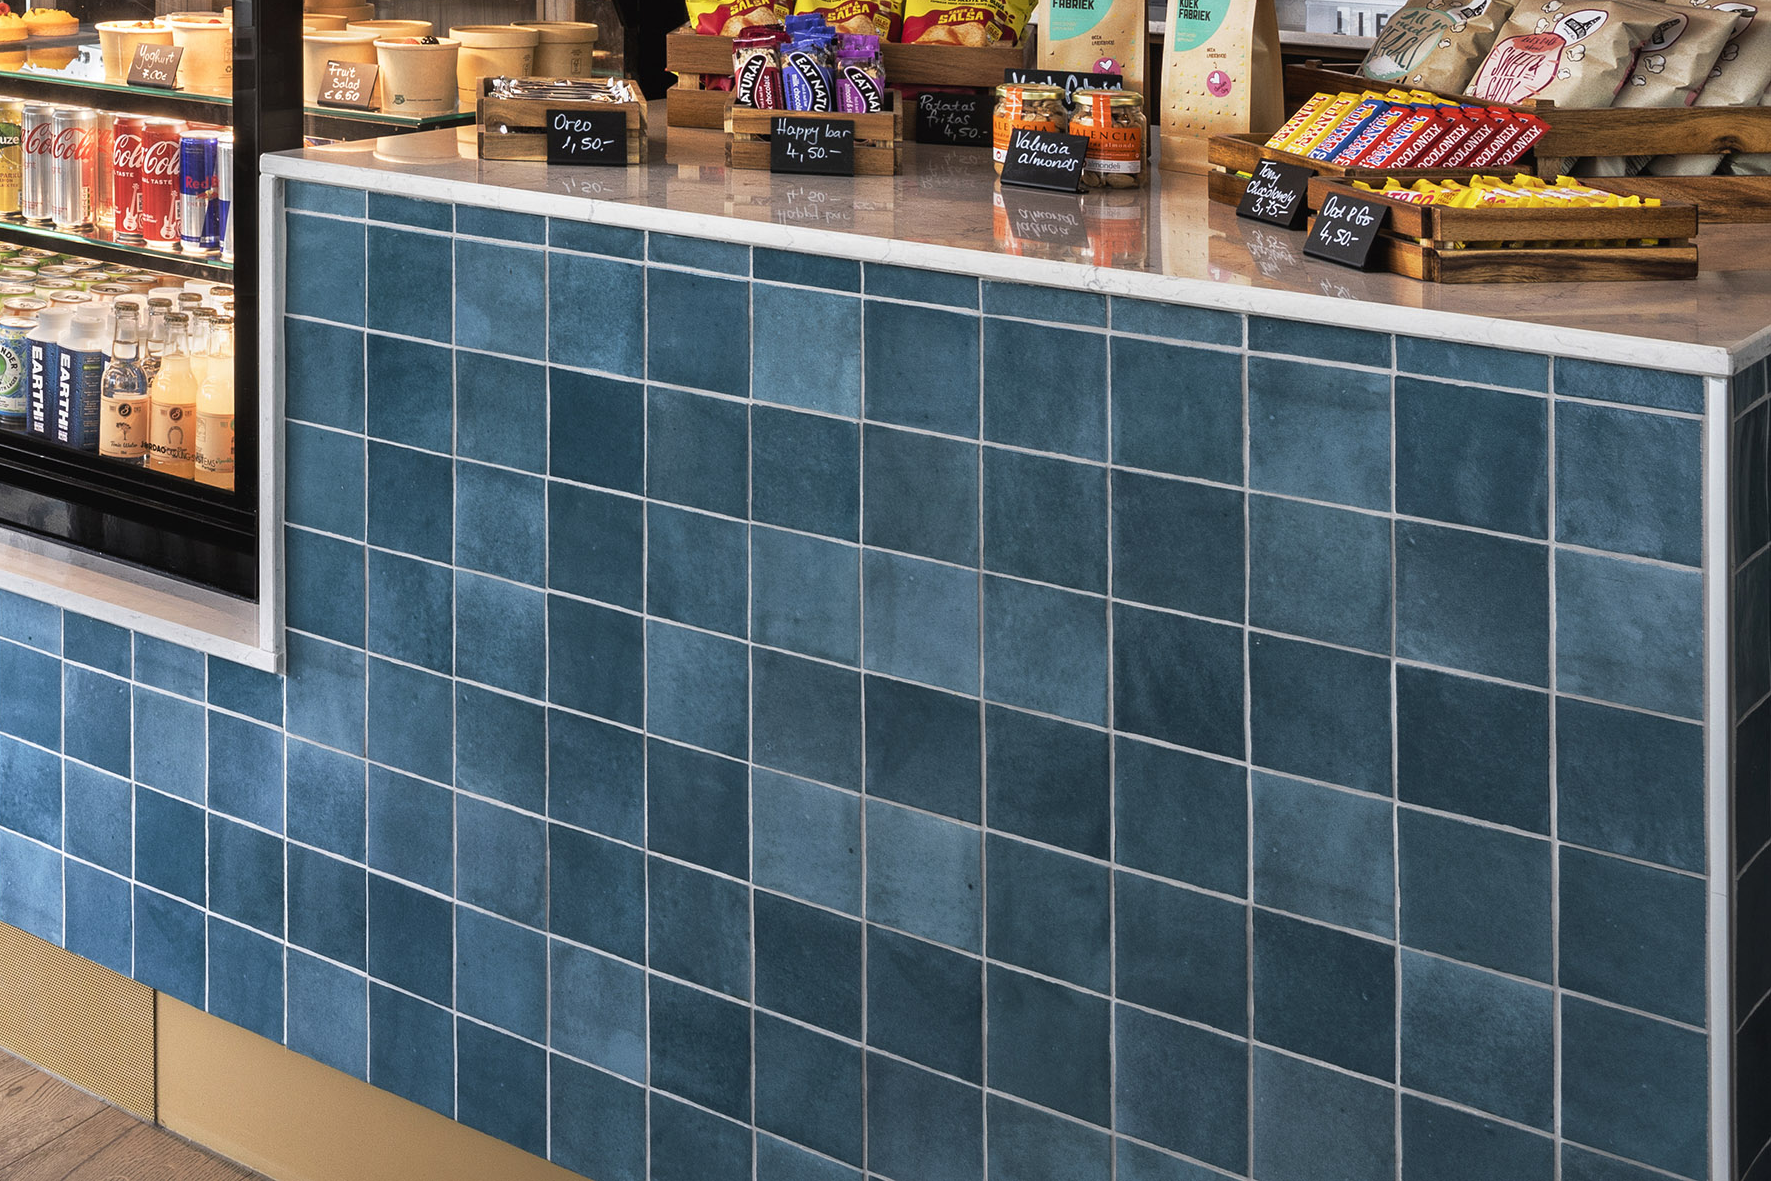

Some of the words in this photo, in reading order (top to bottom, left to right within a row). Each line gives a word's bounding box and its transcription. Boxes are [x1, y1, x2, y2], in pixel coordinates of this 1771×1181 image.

[827, 4, 870, 22] SALSA
[937, 10, 984, 24] SALSA
[1178, 8, 1211, 22] FABRIEK
[134, 44, 175, 70] Yoghurt
[328, 62, 356, 78] Fruit
[795, 57, 813, 81] EAT
[332, 77, 361, 90] Salad
[851, 71, 868, 91] EAT
[324, 90, 334, 99] €
[334, 90, 360, 101] 6.50
[919, 94, 976, 112] Patatas
[554, 113, 592, 132] Oreo
[926, 111, 971, 126] fritas
[776, 117, 820, 145] Happy
[825, 124, 852, 139] bar
[786, 143, 842, 162] 4,50.-
[1015, 131, 1071, 155] Valencia
[1017, 152, 1079, 172] almonds
[185, 175, 210, 190] Red
[1259, 160, 1282, 188] Tony
[1319, 221, 1359, 247] 4,50.-
